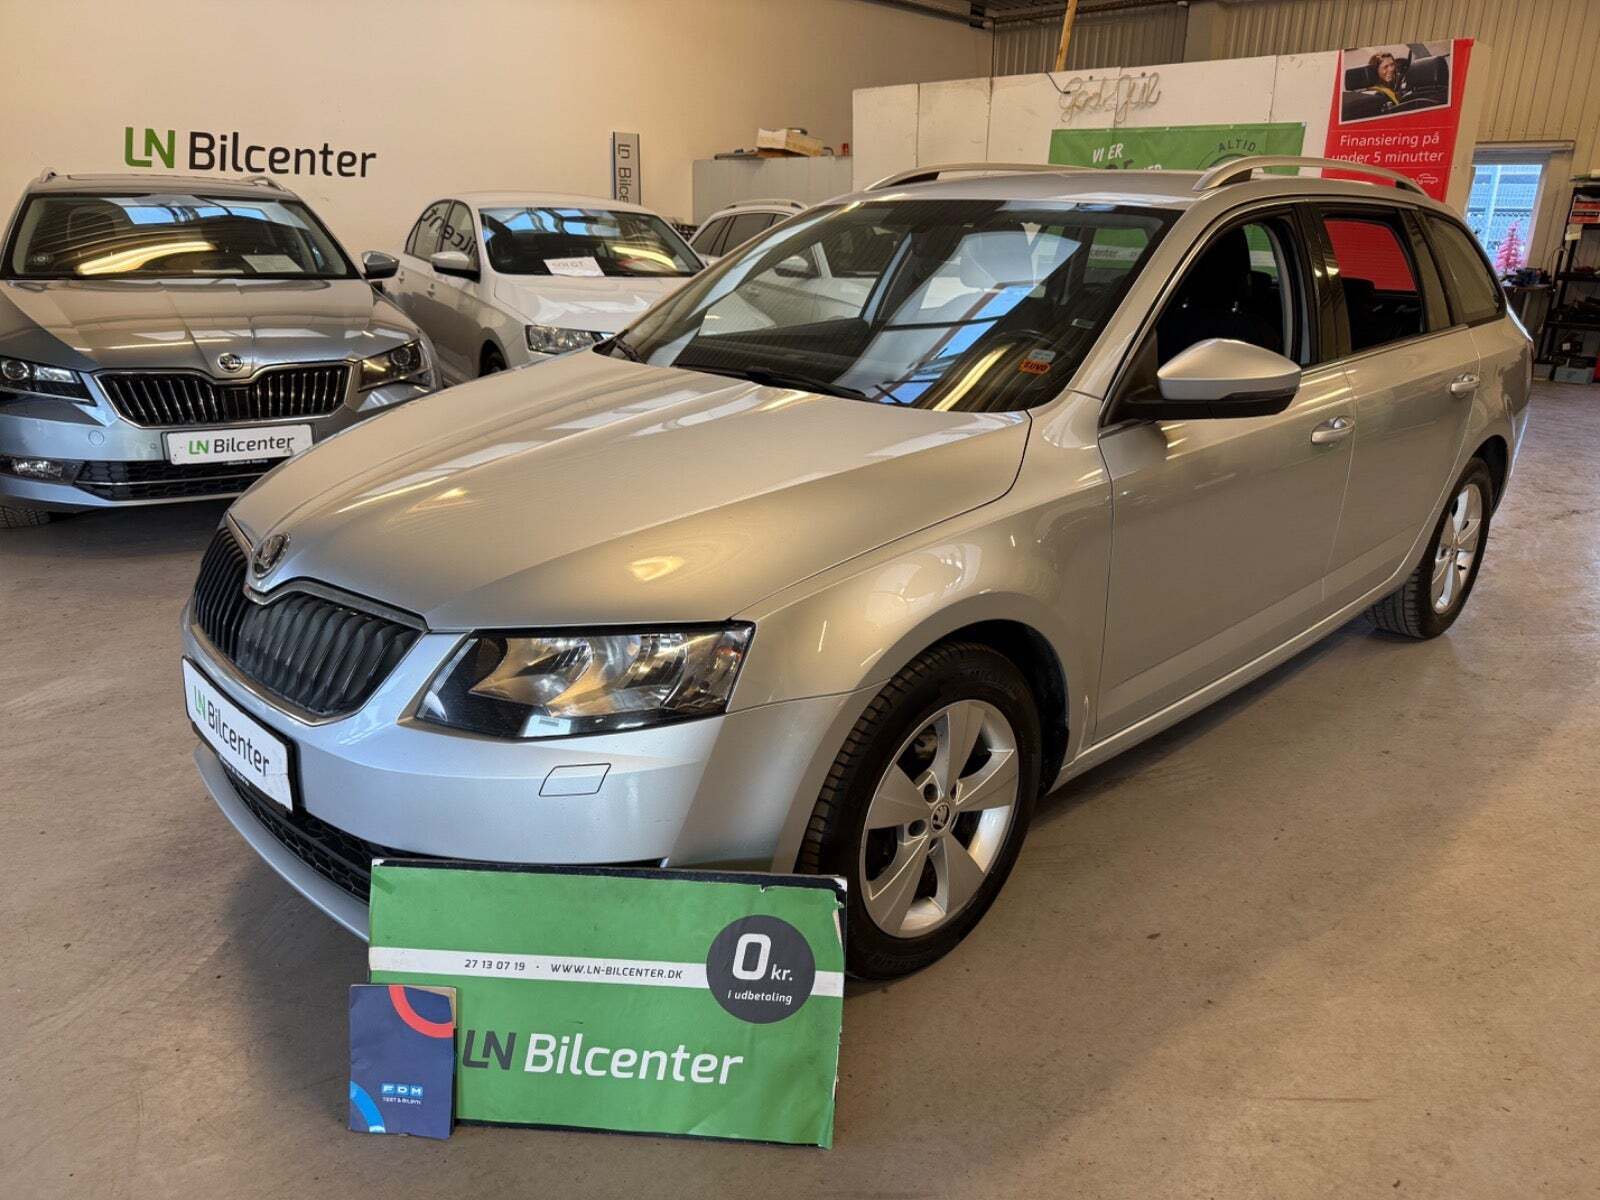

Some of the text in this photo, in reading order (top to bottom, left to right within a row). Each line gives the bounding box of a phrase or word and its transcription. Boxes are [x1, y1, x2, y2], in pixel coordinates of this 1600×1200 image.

[1217, 138, 1257, 153] ALTID
[1340, 131, 1440, 148] Finansiering på
[124, 127, 377, 178] LN Bilcenter
[1092, 143, 1124, 163] VI ER
[1373, 151, 1382, 163] 5
[1385, 151, 1445, 163] minutter
[188, 436, 295, 455] LN Bilcenter
[194, 685, 206, 721] LN
[207, 700, 270, 777] Bilcenter
[732, 933, 793, 981] 0 kr.
[465, 959, 683, 979] 27 13 07 19 WWW.LN-BILCENTER.DK
[734, 990, 793, 1005] udbetaling
[462, 1029, 744, 1085] LN Bilcenter
